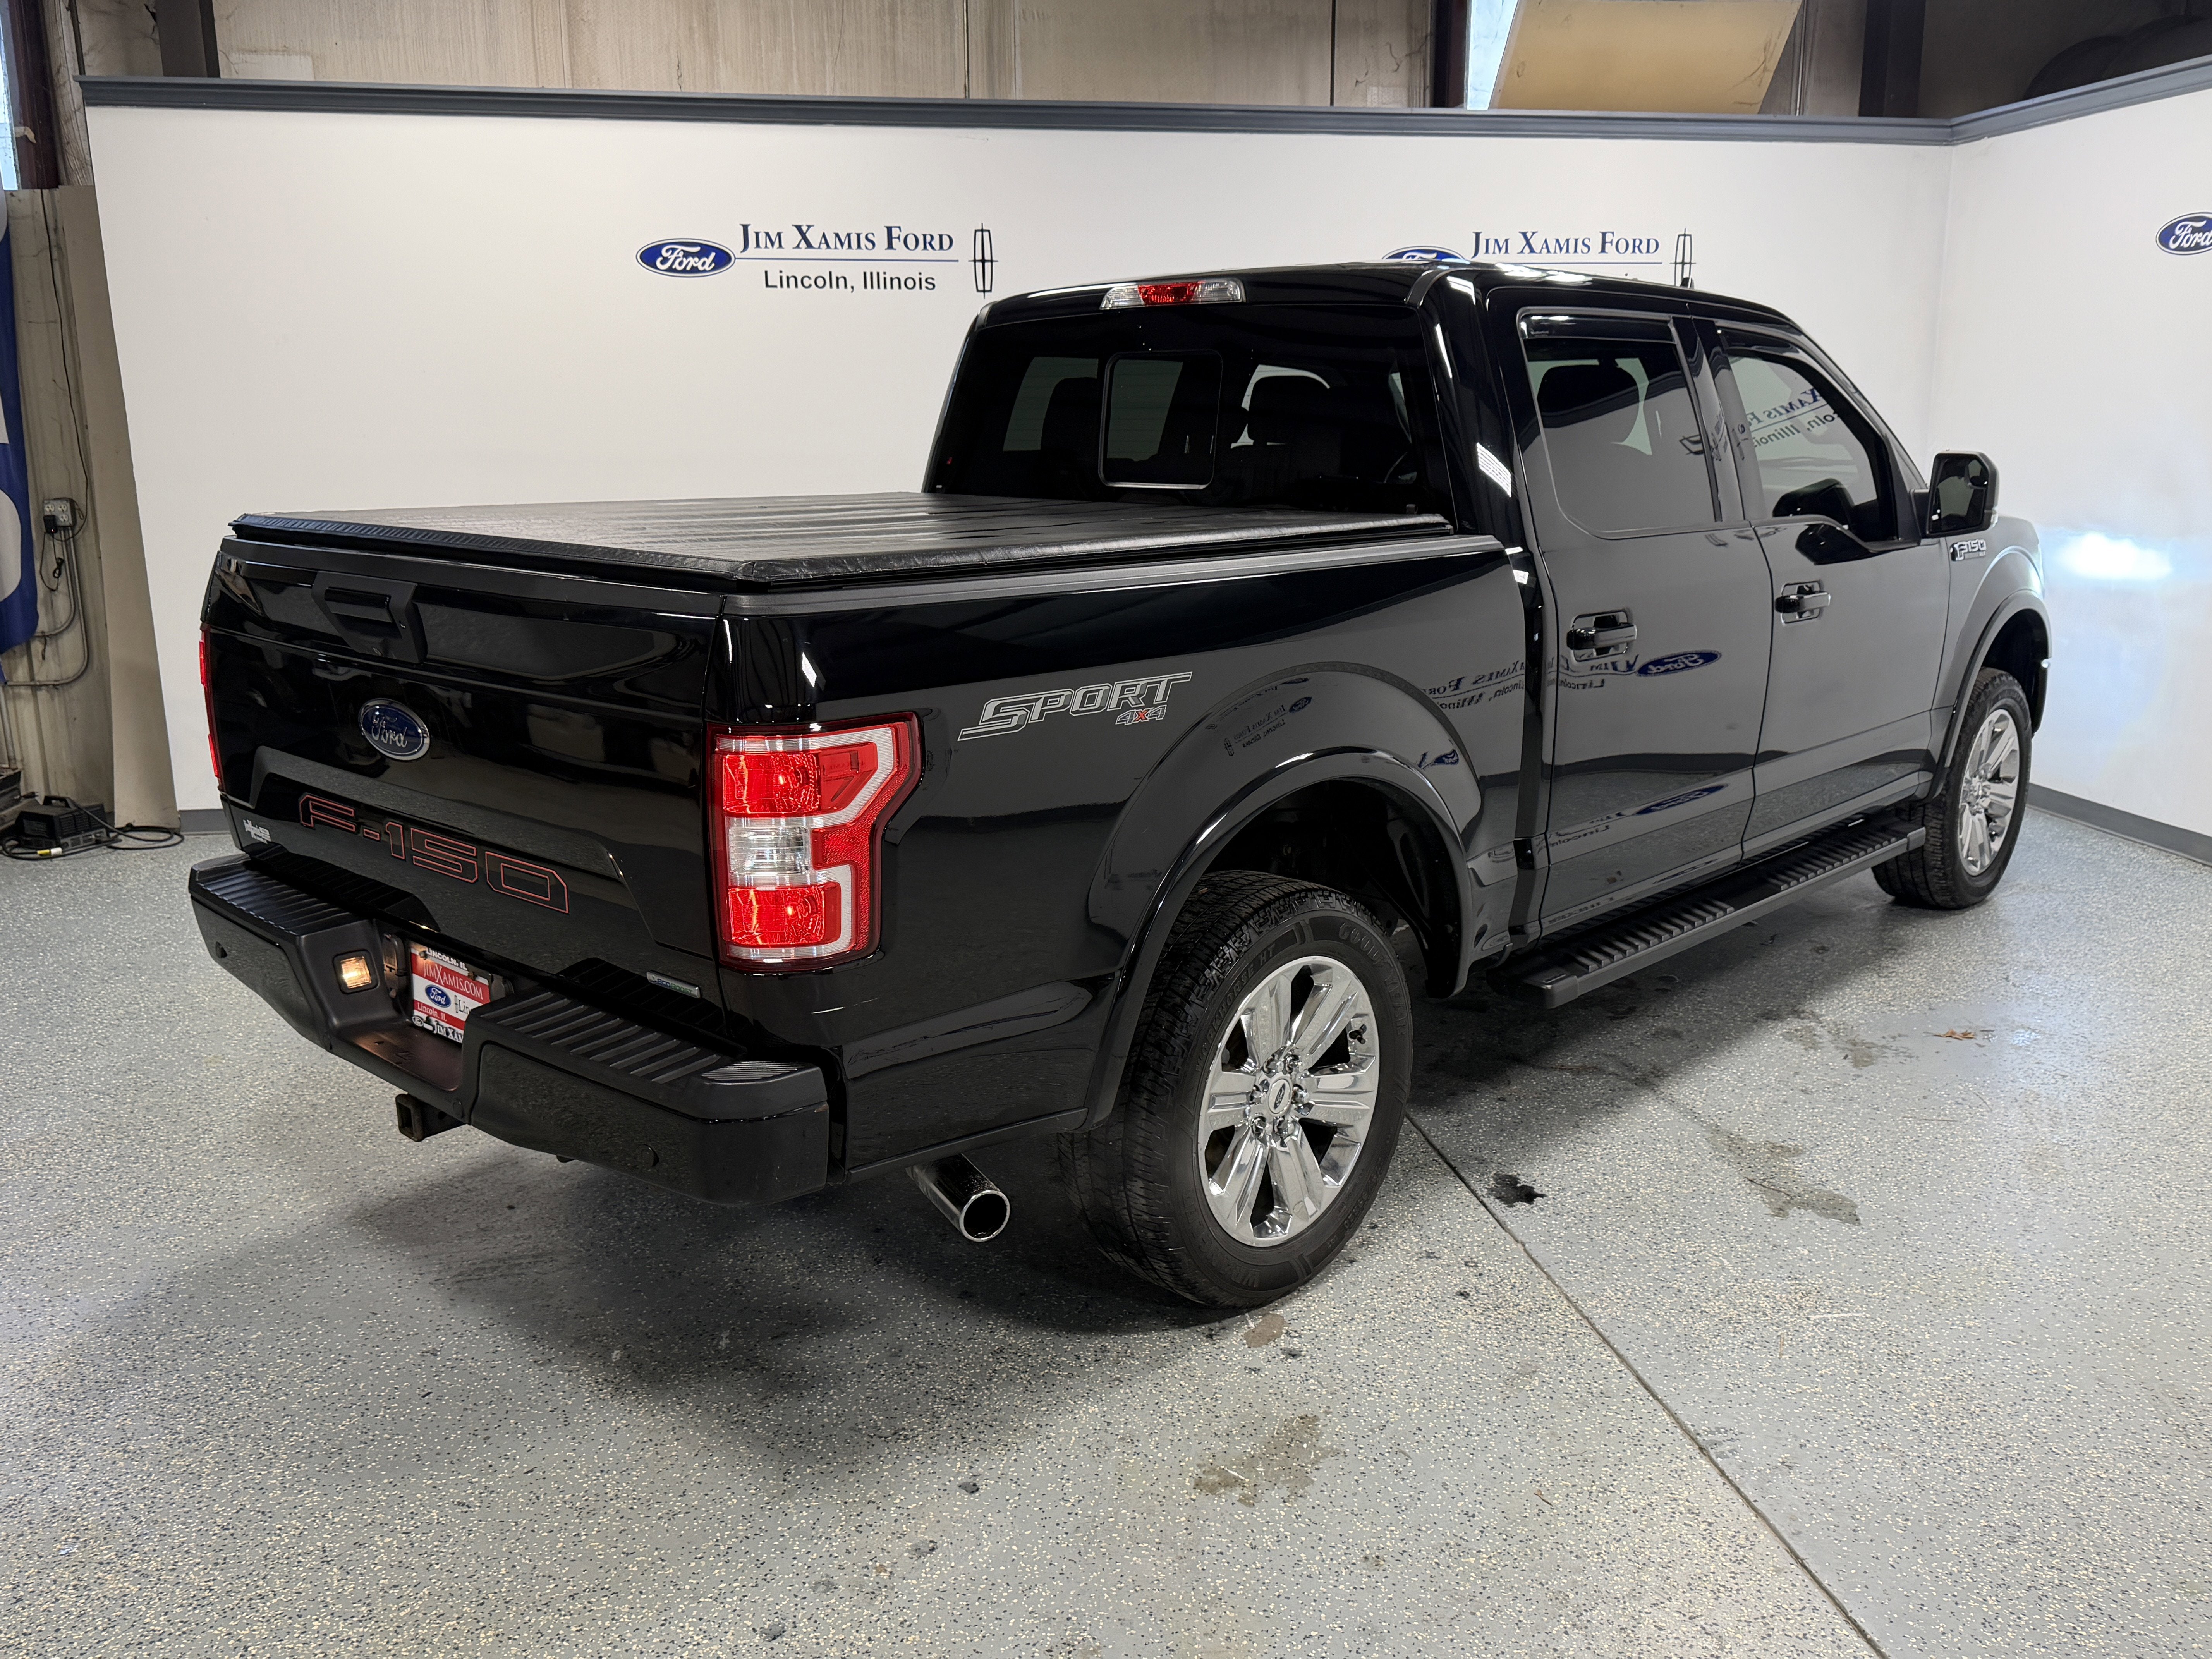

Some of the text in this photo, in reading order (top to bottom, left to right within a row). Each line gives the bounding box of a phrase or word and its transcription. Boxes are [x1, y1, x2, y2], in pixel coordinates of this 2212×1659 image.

[656, 245, 716, 271] Ford
[764, 270, 936, 293] Lincoln, Illinois
[958, 672, 1193, 741] SPORT
[371, 711, 407, 748] Ford
[299, 793, 569, 914] F-150
[430, 988, 446, 1005] Ford
